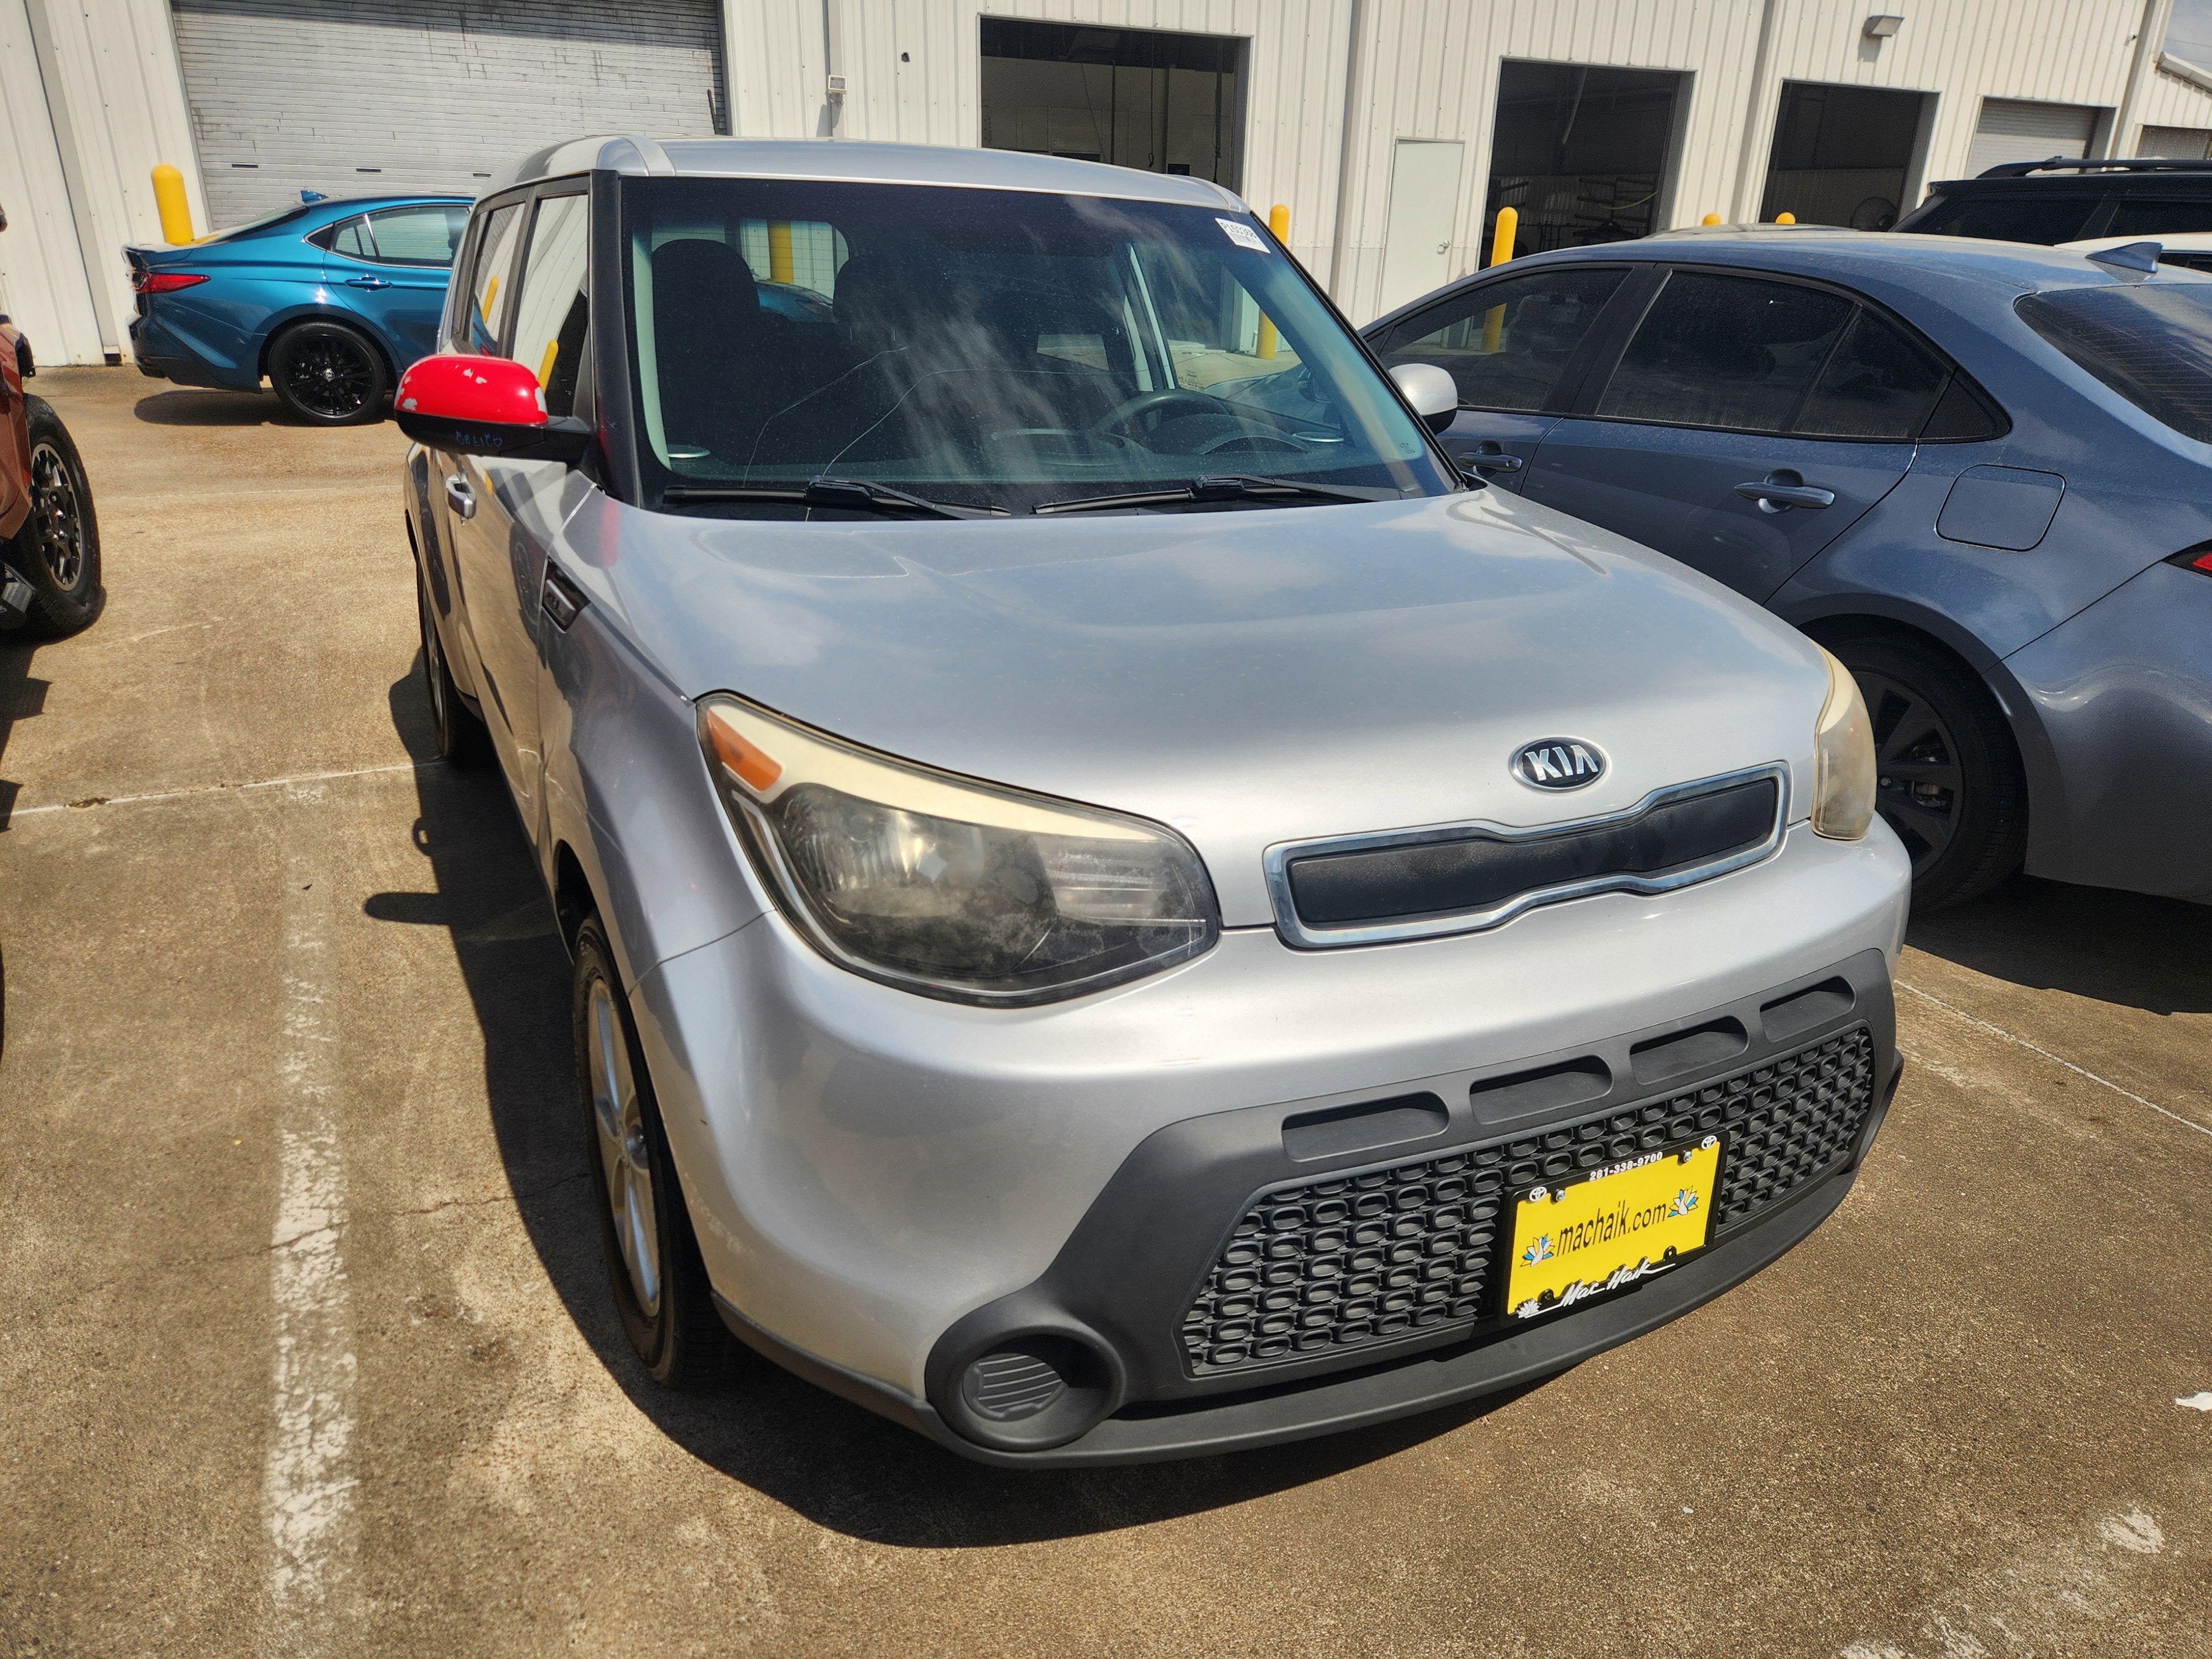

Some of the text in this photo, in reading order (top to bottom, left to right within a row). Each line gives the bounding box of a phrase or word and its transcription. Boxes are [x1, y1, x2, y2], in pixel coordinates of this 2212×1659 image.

[1525, 745, 1599, 781] KIA
[1589, 1151, 1663, 1182] 281-338-9700
[1556, 1199, 1666, 1257] machaik.com
[1560, 1258, 1657, 1307] Mac Haik
